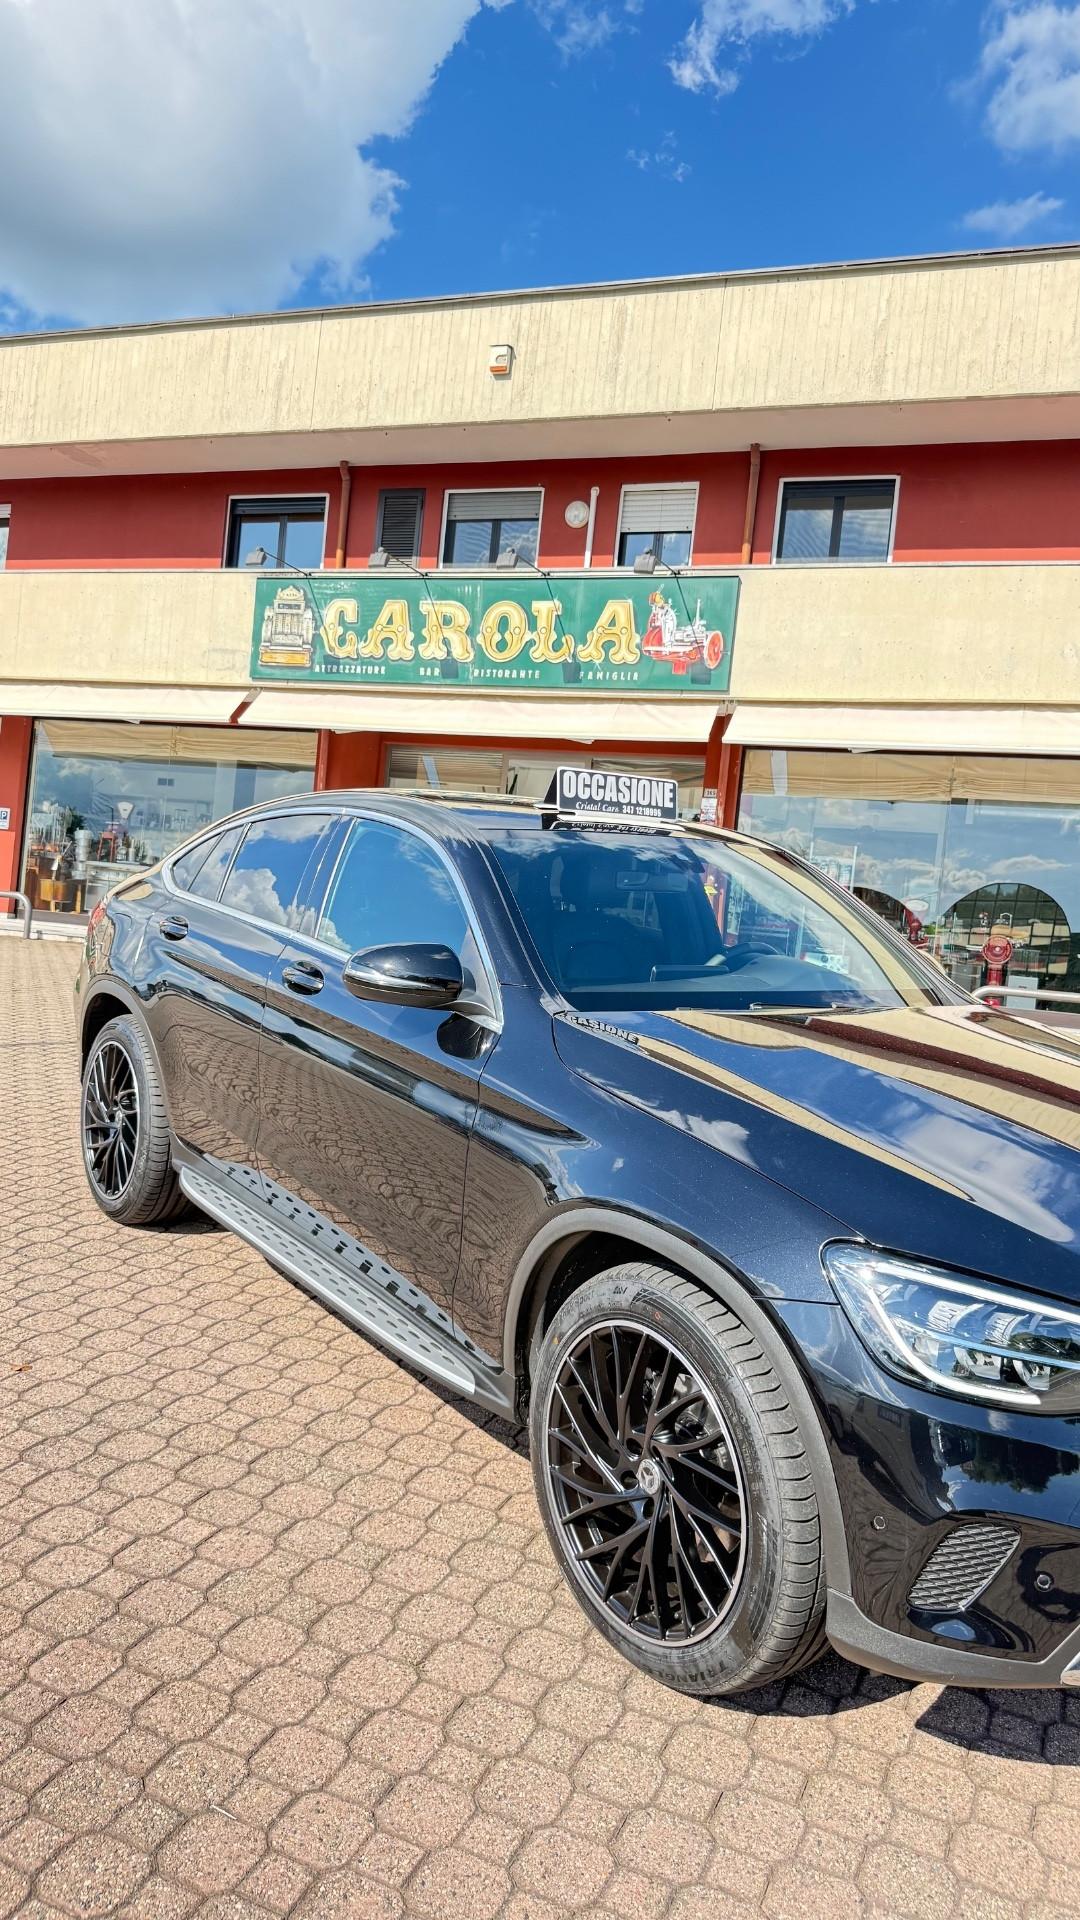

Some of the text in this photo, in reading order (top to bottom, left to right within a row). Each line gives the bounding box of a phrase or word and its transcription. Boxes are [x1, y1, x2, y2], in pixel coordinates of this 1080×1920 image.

[319, 599, 641, 664] CAROLA
[314, 664, 639, 681] ATTREZZATURE BAR RISTORANTE FAMIGLIA
[562, 770, 674, 808] OCCASIONE
[575, 801, 601, 811] Cristal
[602, 804, 620, 812] Cars
[622, 805, 634, 814] 347
